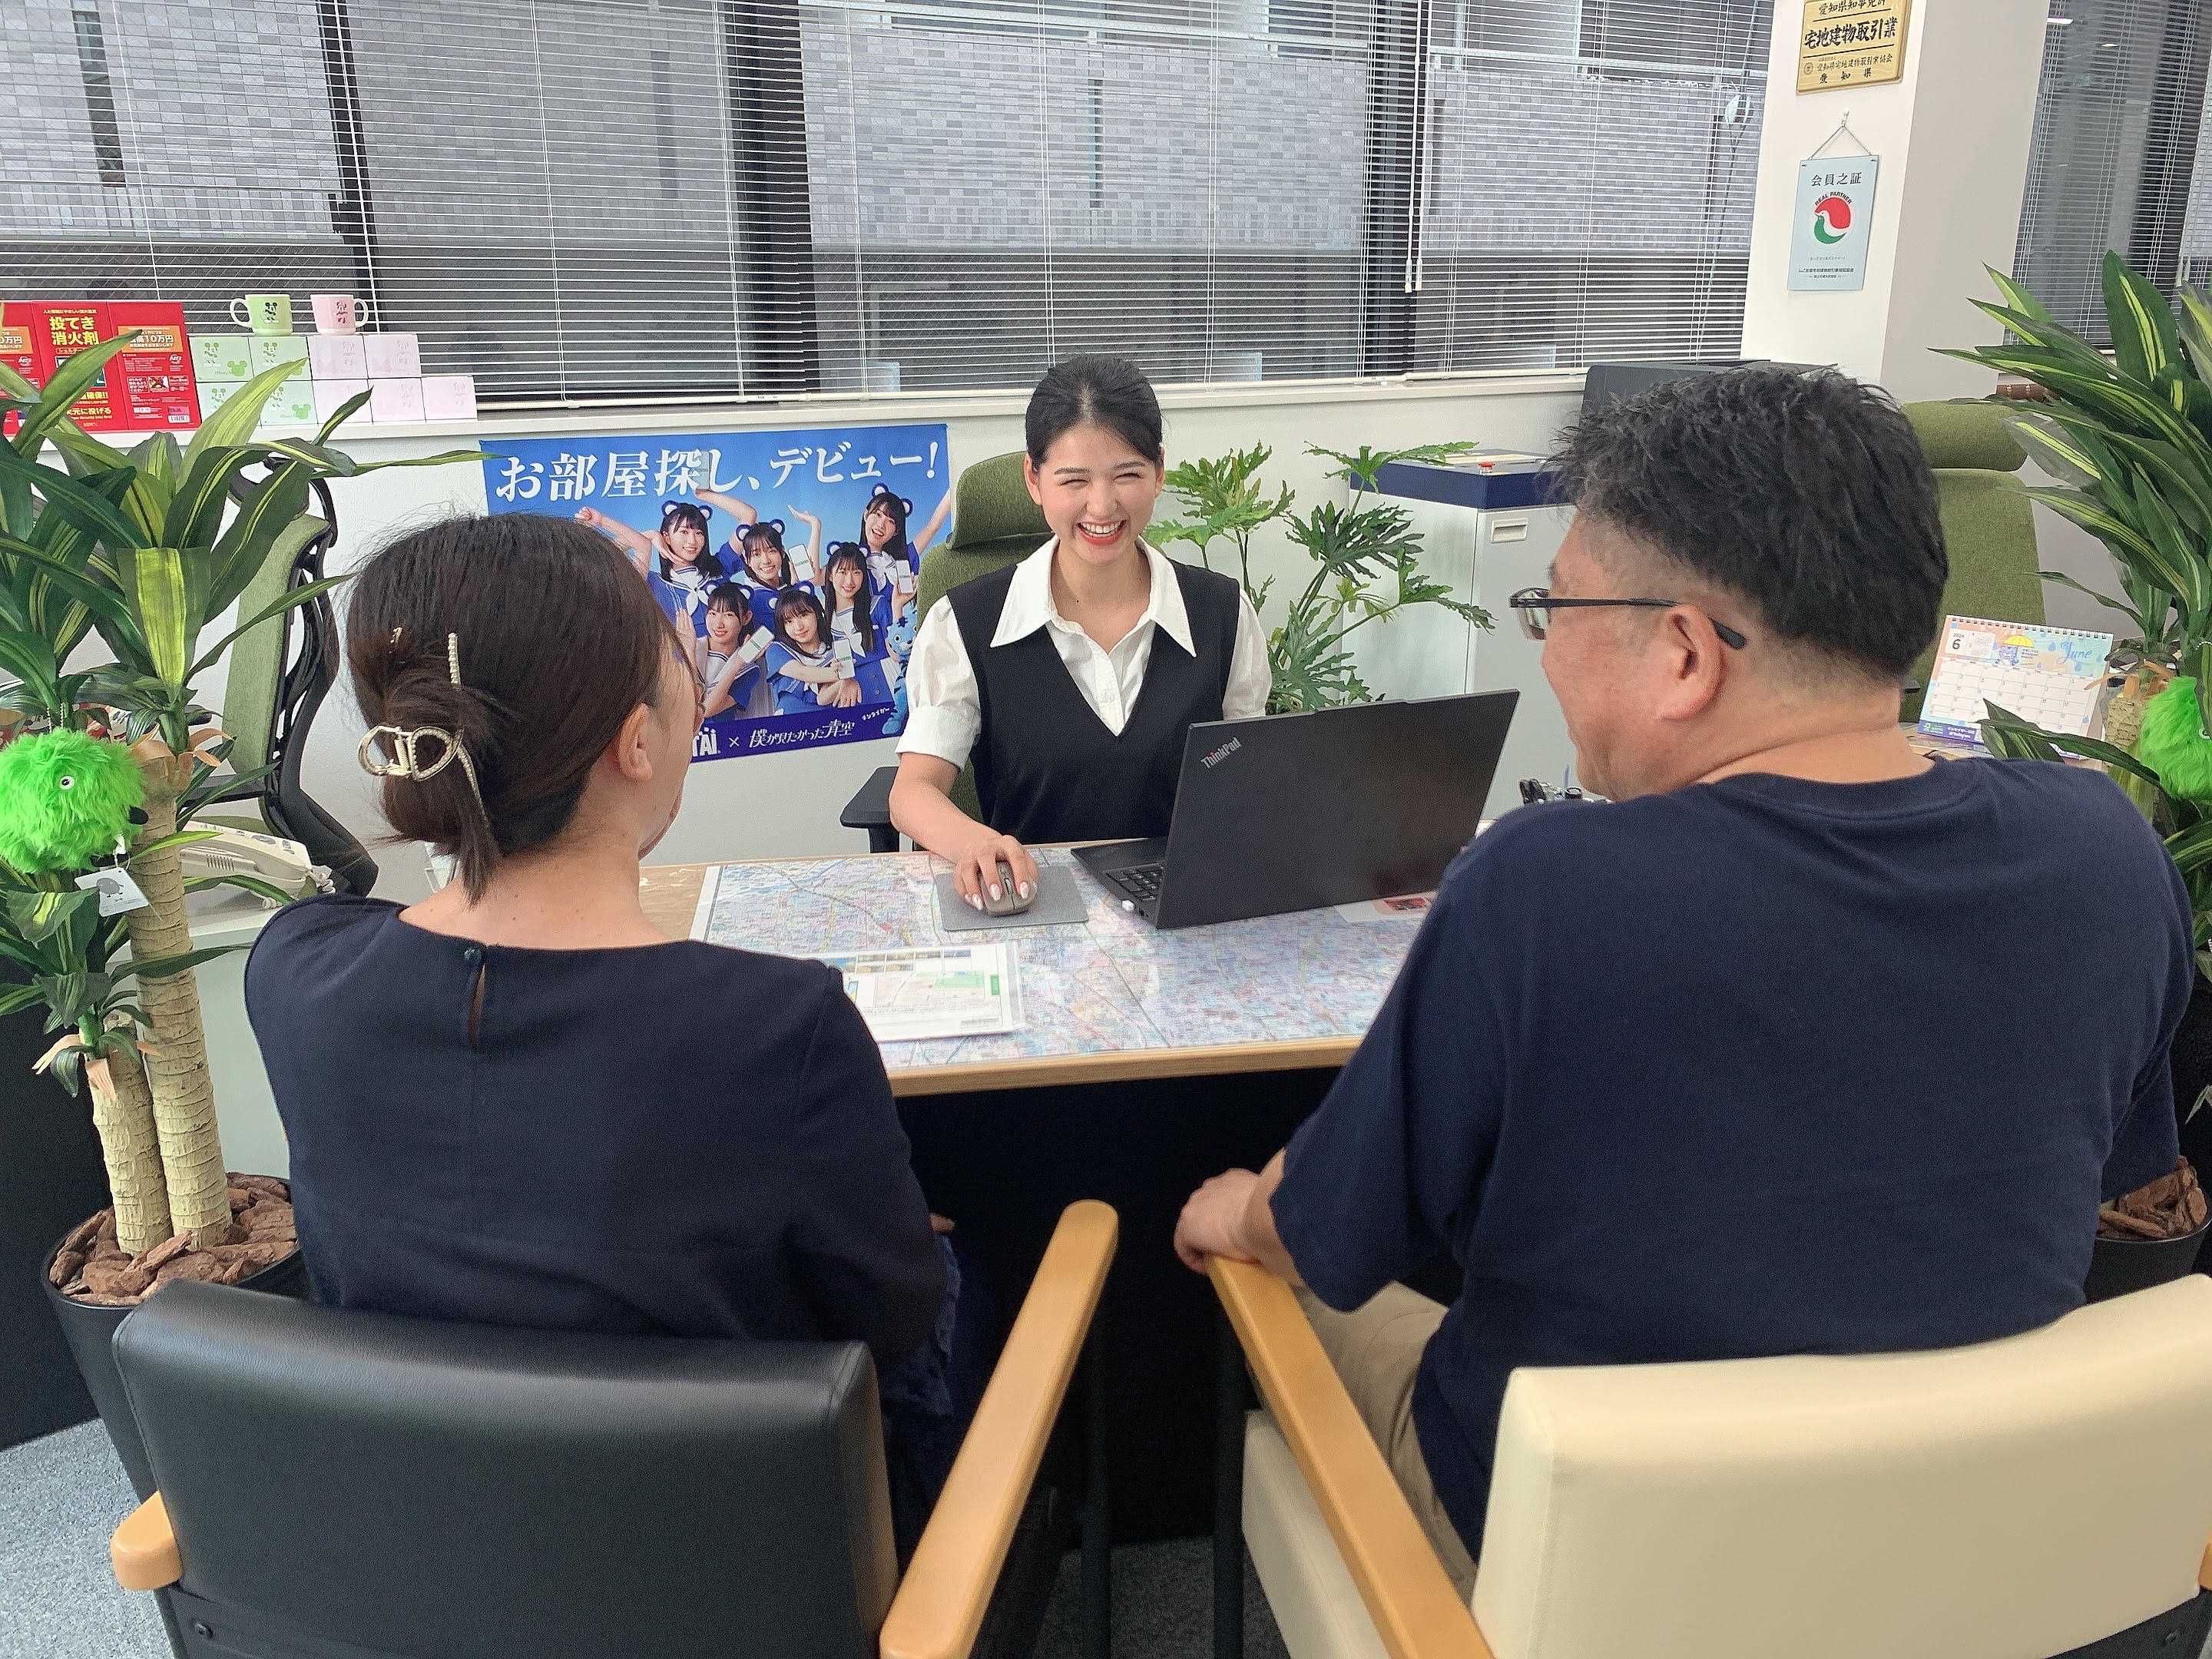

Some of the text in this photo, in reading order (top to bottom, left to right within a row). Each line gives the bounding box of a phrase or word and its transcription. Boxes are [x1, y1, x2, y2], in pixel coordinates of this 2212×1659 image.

[1804, 16, 1899, 49] 宅地建物取引業
[1811, 172, 1863, 187] 会員之証
[1815, 191, 1852, 206] REAL PARTNER
[49, 316, 94, 330] 投てき
[51, 331, 100, 346] 消火剤
[1952, 639, 1961, 650] 6
[2058, 641, 2094, 664] June
[1200, 737, 1241, 768] ThinkPad
